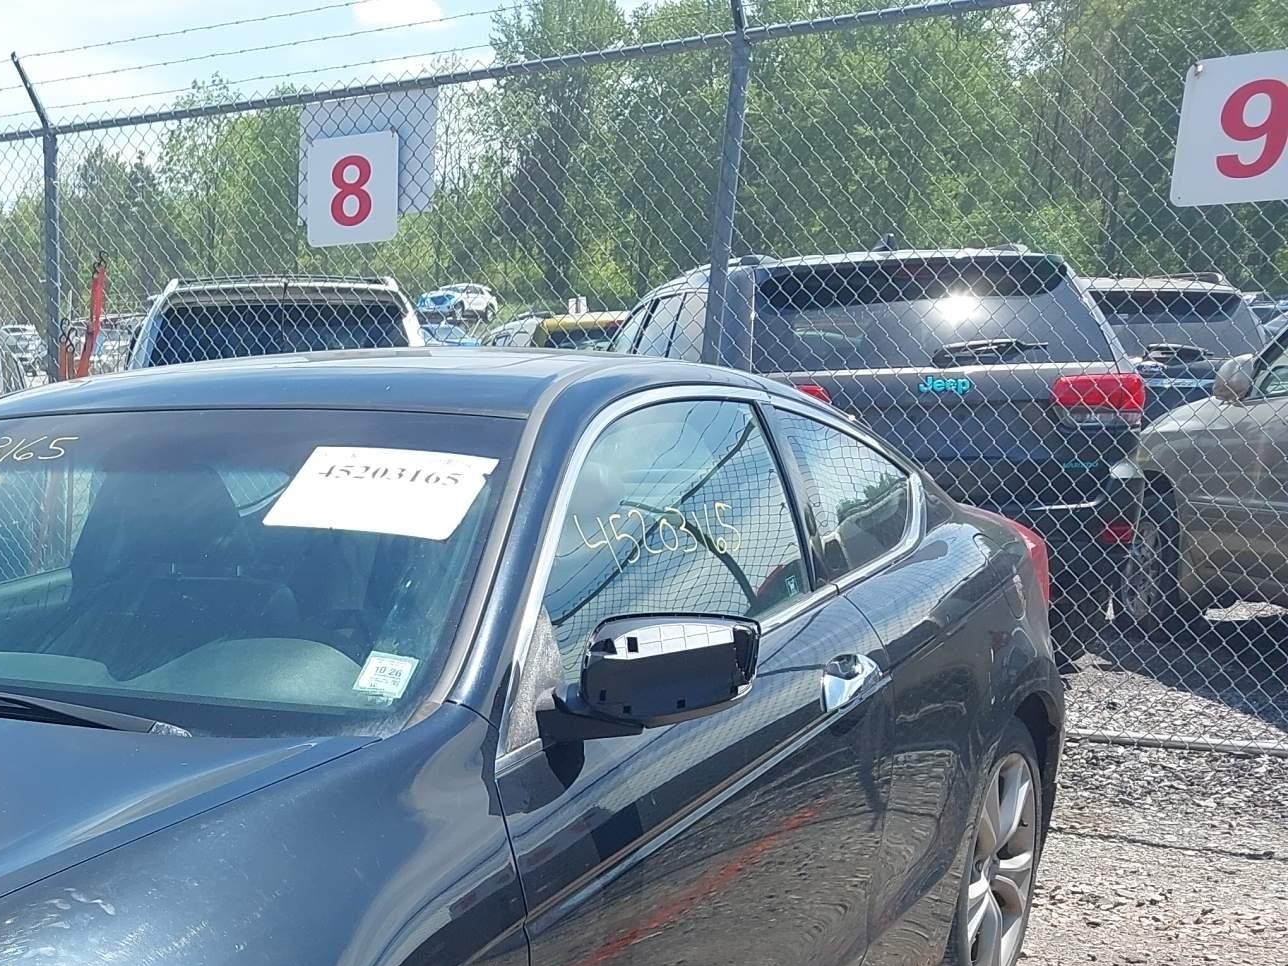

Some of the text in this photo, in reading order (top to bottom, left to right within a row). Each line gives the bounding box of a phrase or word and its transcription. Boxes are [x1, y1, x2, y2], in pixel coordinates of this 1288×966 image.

[1215, 78, 1288, 180] 9
[330, 154, 373, 228] 8
[918, 376, 971, 395] Jeep
[318, 464, 464, 487] 45203165
